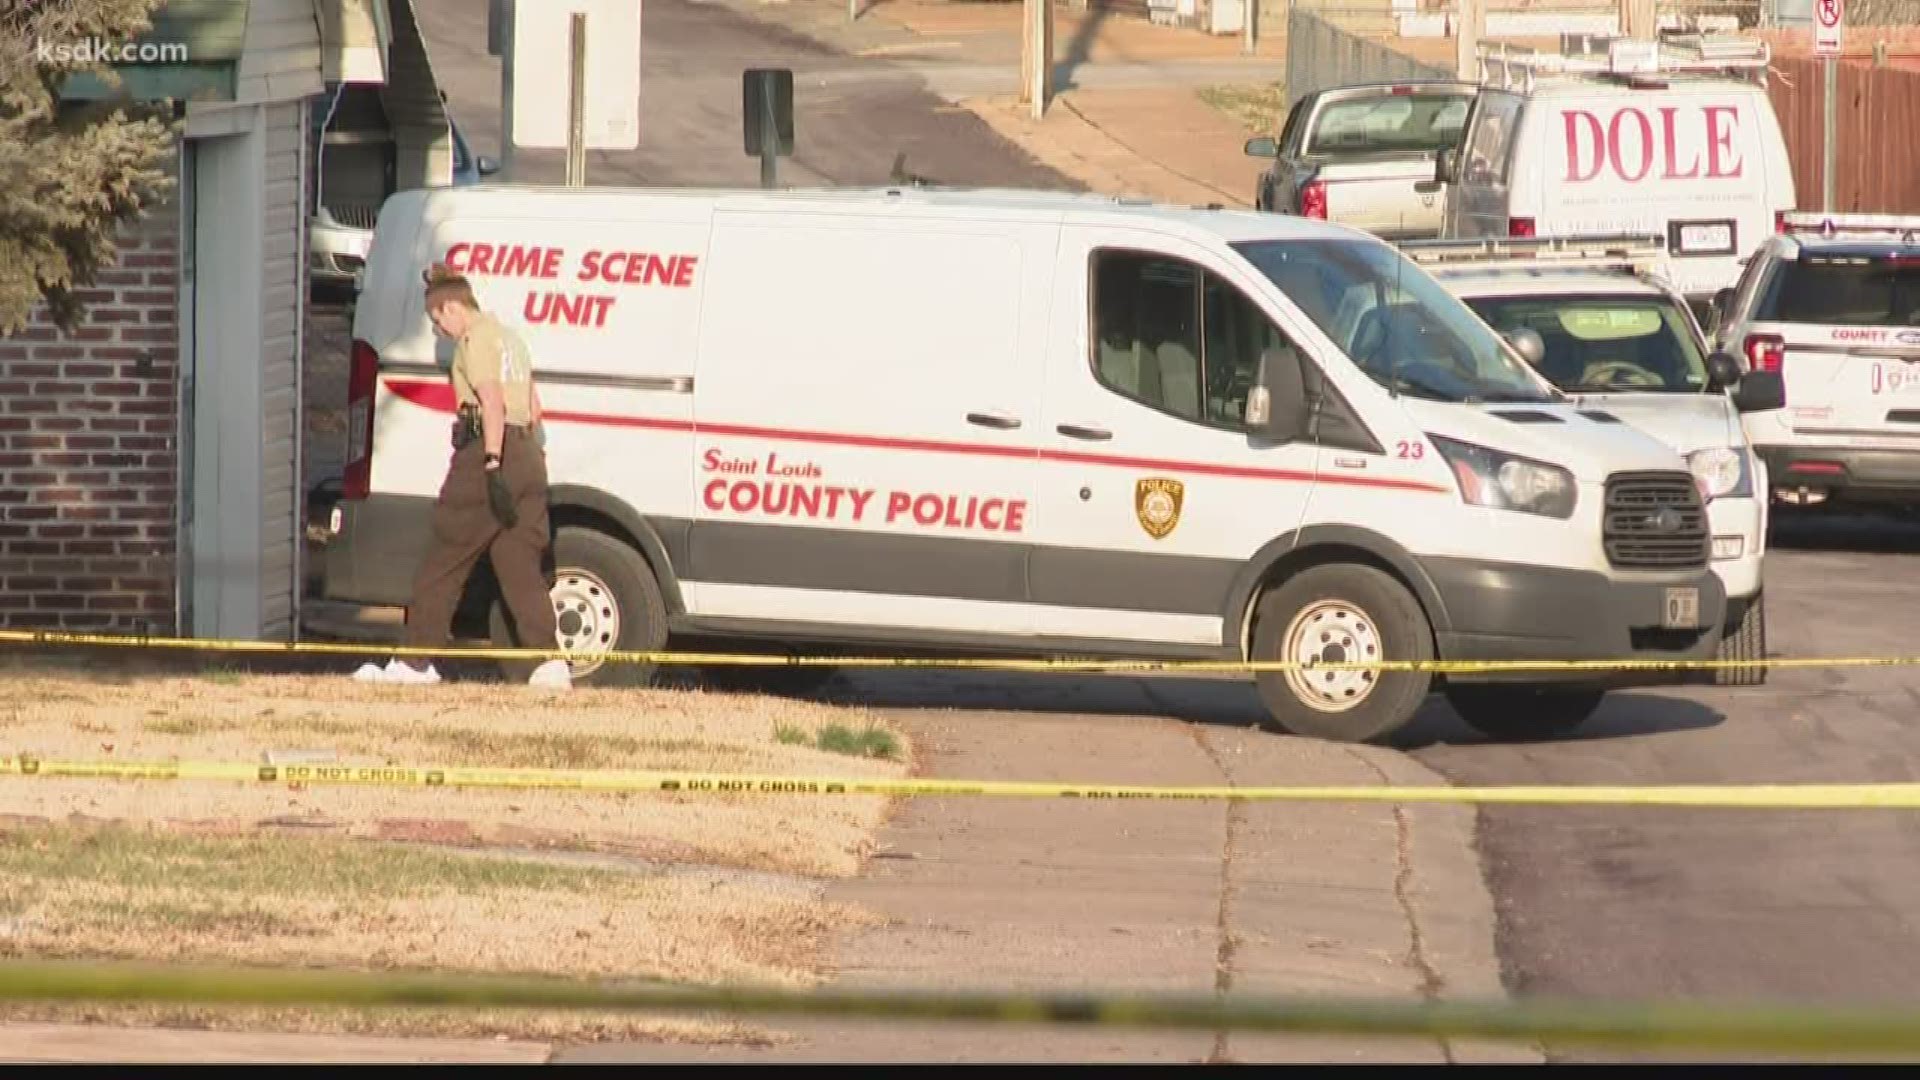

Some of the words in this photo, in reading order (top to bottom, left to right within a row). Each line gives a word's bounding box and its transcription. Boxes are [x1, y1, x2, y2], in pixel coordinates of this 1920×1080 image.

[1561, 105, 1743, 183] DOLE
[445, 242, 563, 279] CRIME
[577, 250, 697, 287] SCENE
[523, 291, 616, 327] UNIT
[1831, 329, 1888, 342] COUNTY
[1397, 440, 1424, 459] 23
[703, 448, 757, 474] Saint
[766, 452, 822, 477] Louis
[1140, 479, 1181, 495] POLICE
[703, 479, 876, 520] COUNTY
[886, 491, 1027, 532] POLICE
[286, 767, 310, 778] DO
[316, 768, 351, 780] NOT
[359, 768, 418, 783] CROSS
[688, 780, 712, 791] DO
[718, 780, 753, 792] NOT
[759, 780, 818, 793] CROSS
